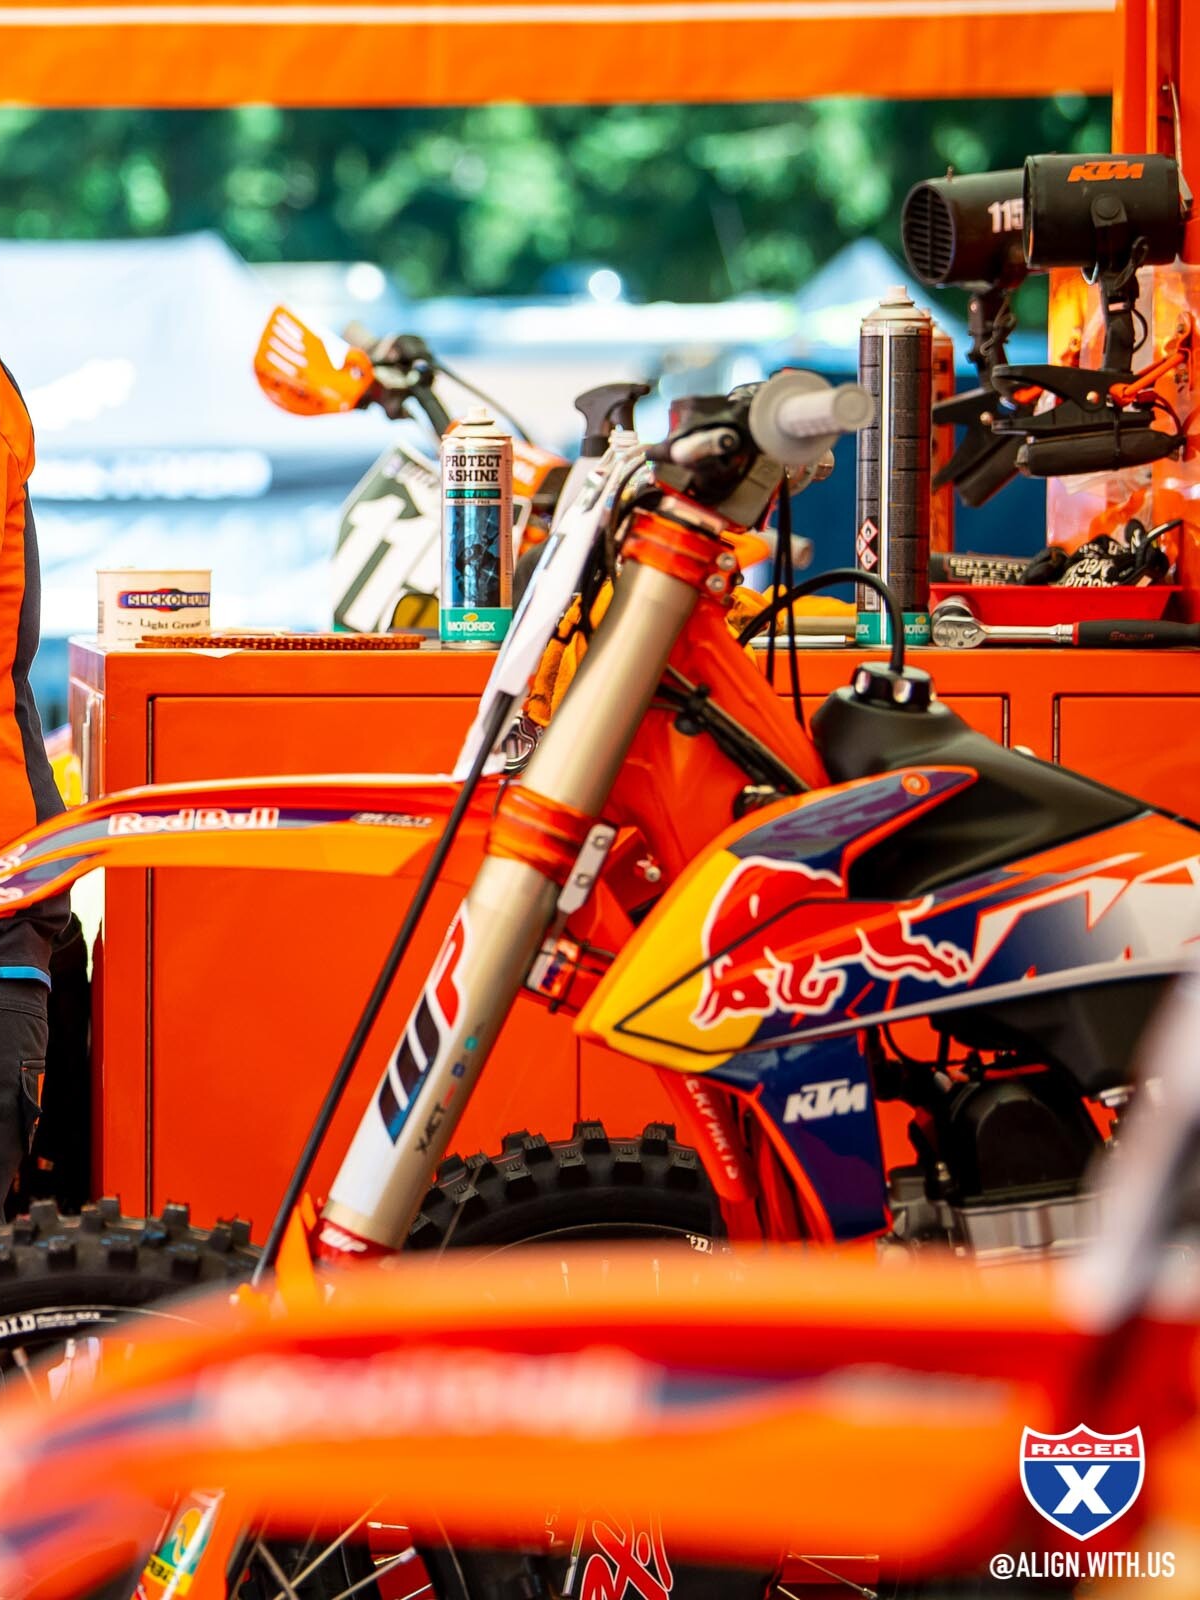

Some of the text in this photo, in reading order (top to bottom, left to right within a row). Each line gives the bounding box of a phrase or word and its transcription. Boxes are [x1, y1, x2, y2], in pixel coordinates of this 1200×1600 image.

[1067, 161, 1144, 183] KTM
[445, 454, 502, 468] PROTECT
[140, 618, 168, 630] Light
[447, 621, 496, 632] MOTOREX
[109, 807, 280, 836] Red Bull
[783, 1078, 868, 1124] KTM
